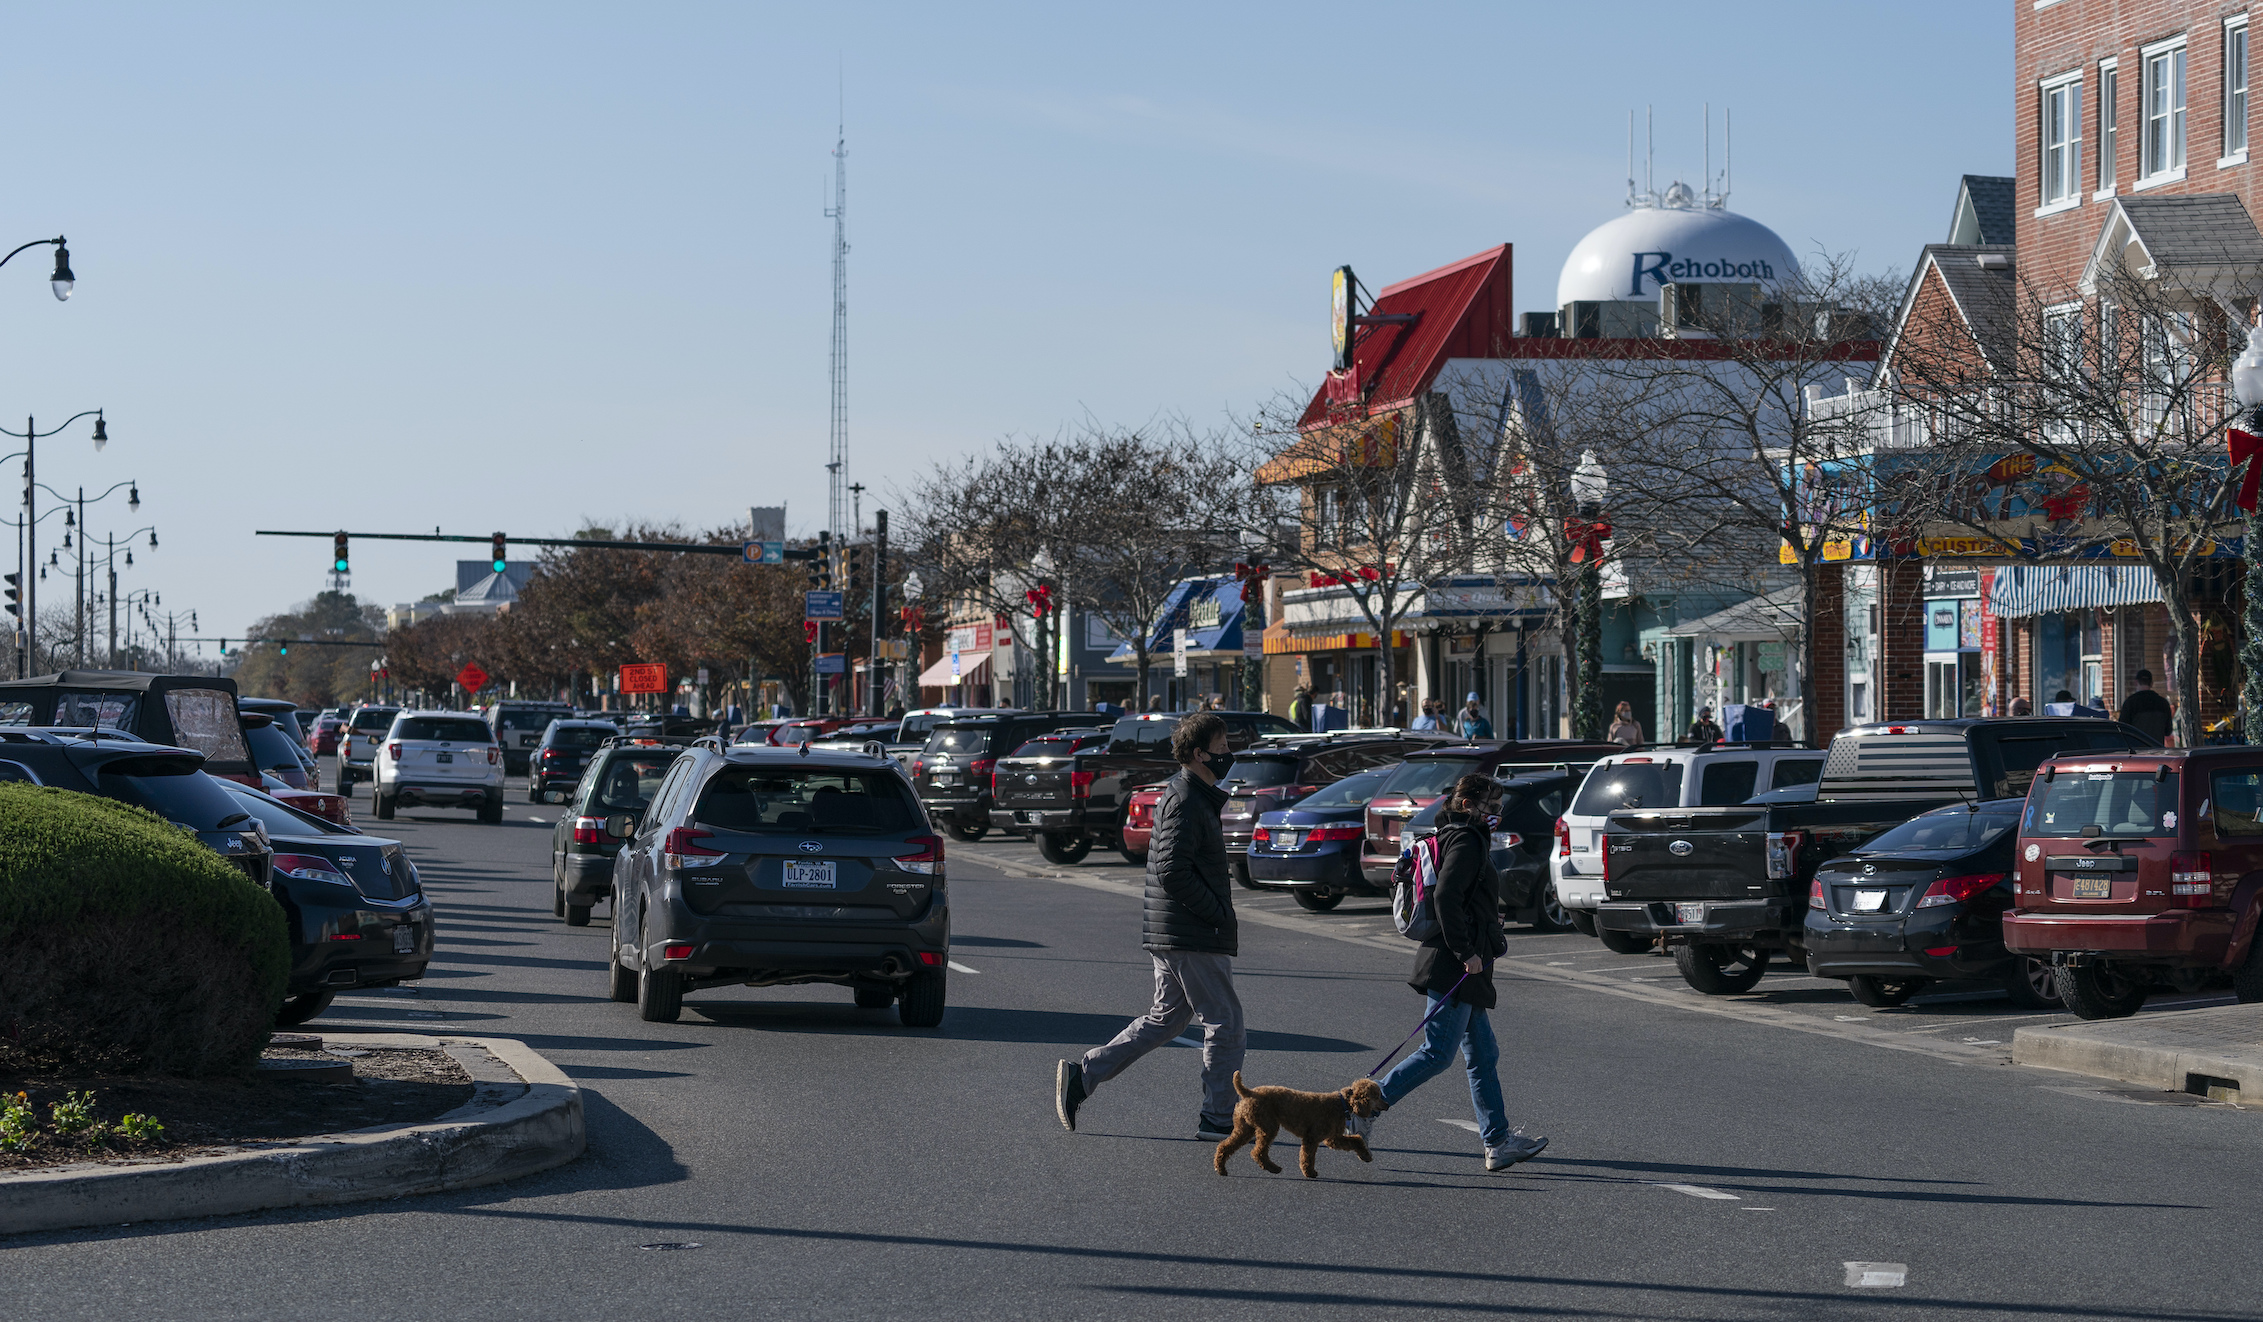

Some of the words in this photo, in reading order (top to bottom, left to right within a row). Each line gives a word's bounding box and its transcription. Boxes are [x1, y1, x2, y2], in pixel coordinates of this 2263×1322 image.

[1628, 252, 1774, 296] Rehoboth
[1999, 454, 2033, 477] THE
[629, 675, 658, 683] CLOSED
[227, 837, 243, 850] Jeep
[338, 855, 357, 863] ACURA
[2076, 858, 2096, 869] Jeep
[787, 868, 831, 881] ULP-2801
